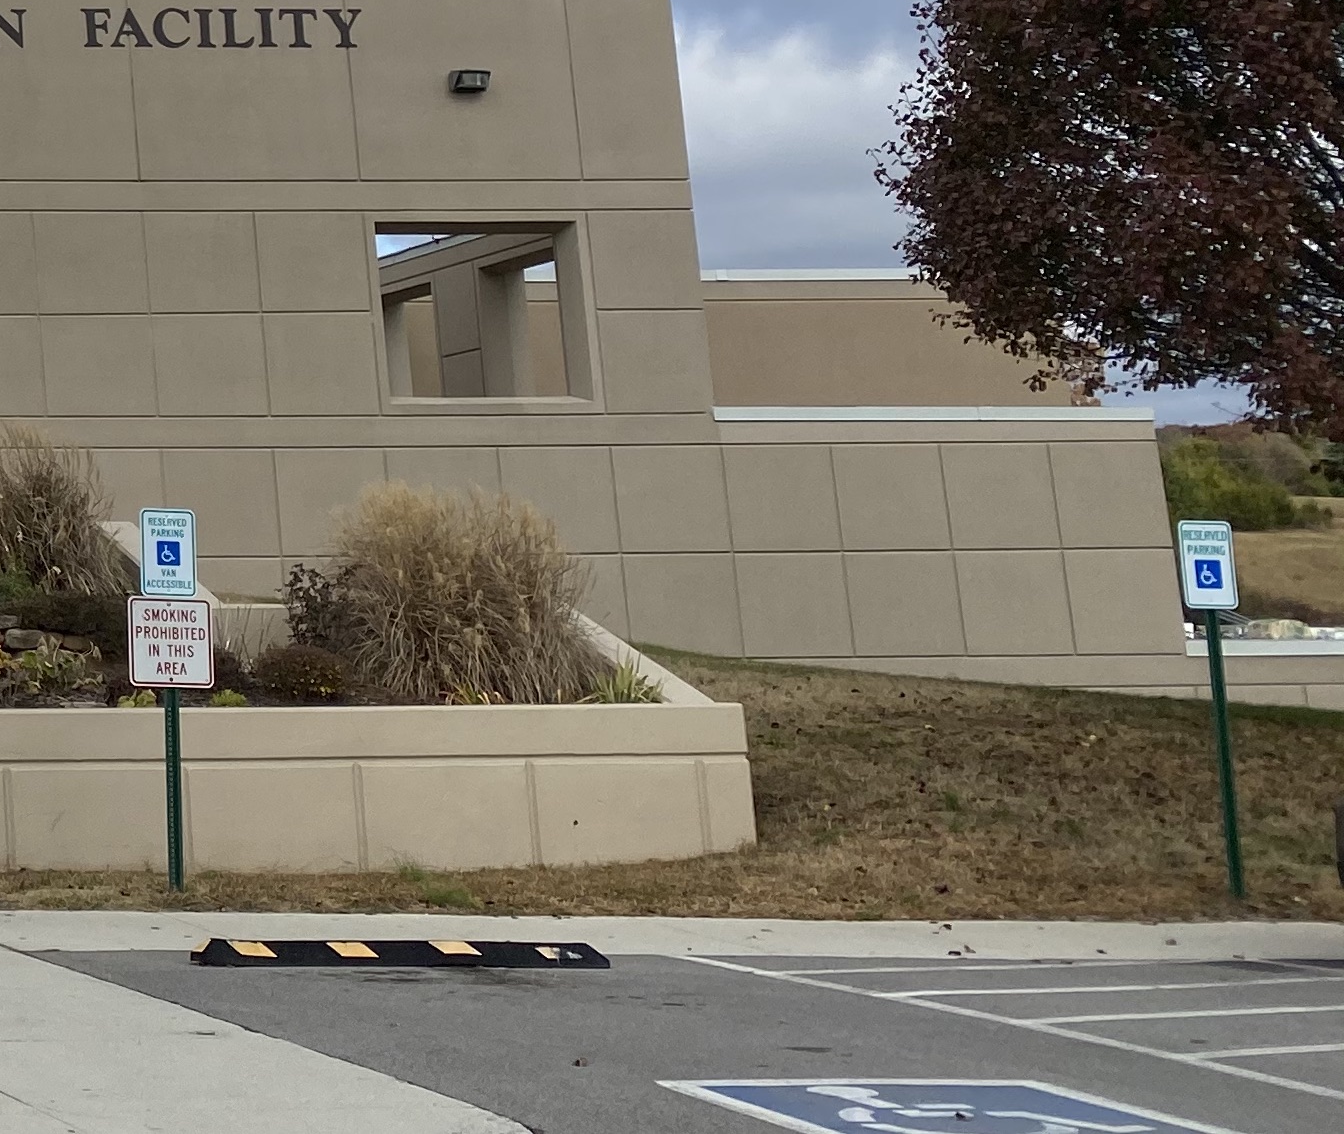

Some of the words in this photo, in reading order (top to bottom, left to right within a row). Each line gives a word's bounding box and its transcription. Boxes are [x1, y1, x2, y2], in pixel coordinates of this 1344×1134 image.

[80, 7, 362, 50] FACILITY
[147, 517, 187, 528] RESERVED
[150, 528, 185, 539] PARKING
[1182, 529, 1228, 541] RESERVED
[1187, 544, 1226, 556] PARKING
[161, 568, 177, 578] VAN
[146, 579, 193, 590] ACCESSIBLE
[143, 608, 197, 623] SMOKING
[135, 625, 206, 641] PROHIBITED
[148, 644, 160, 657] IN
[167, 644, 194, 658] THIS
[156, 662, 187, 676] AREA
